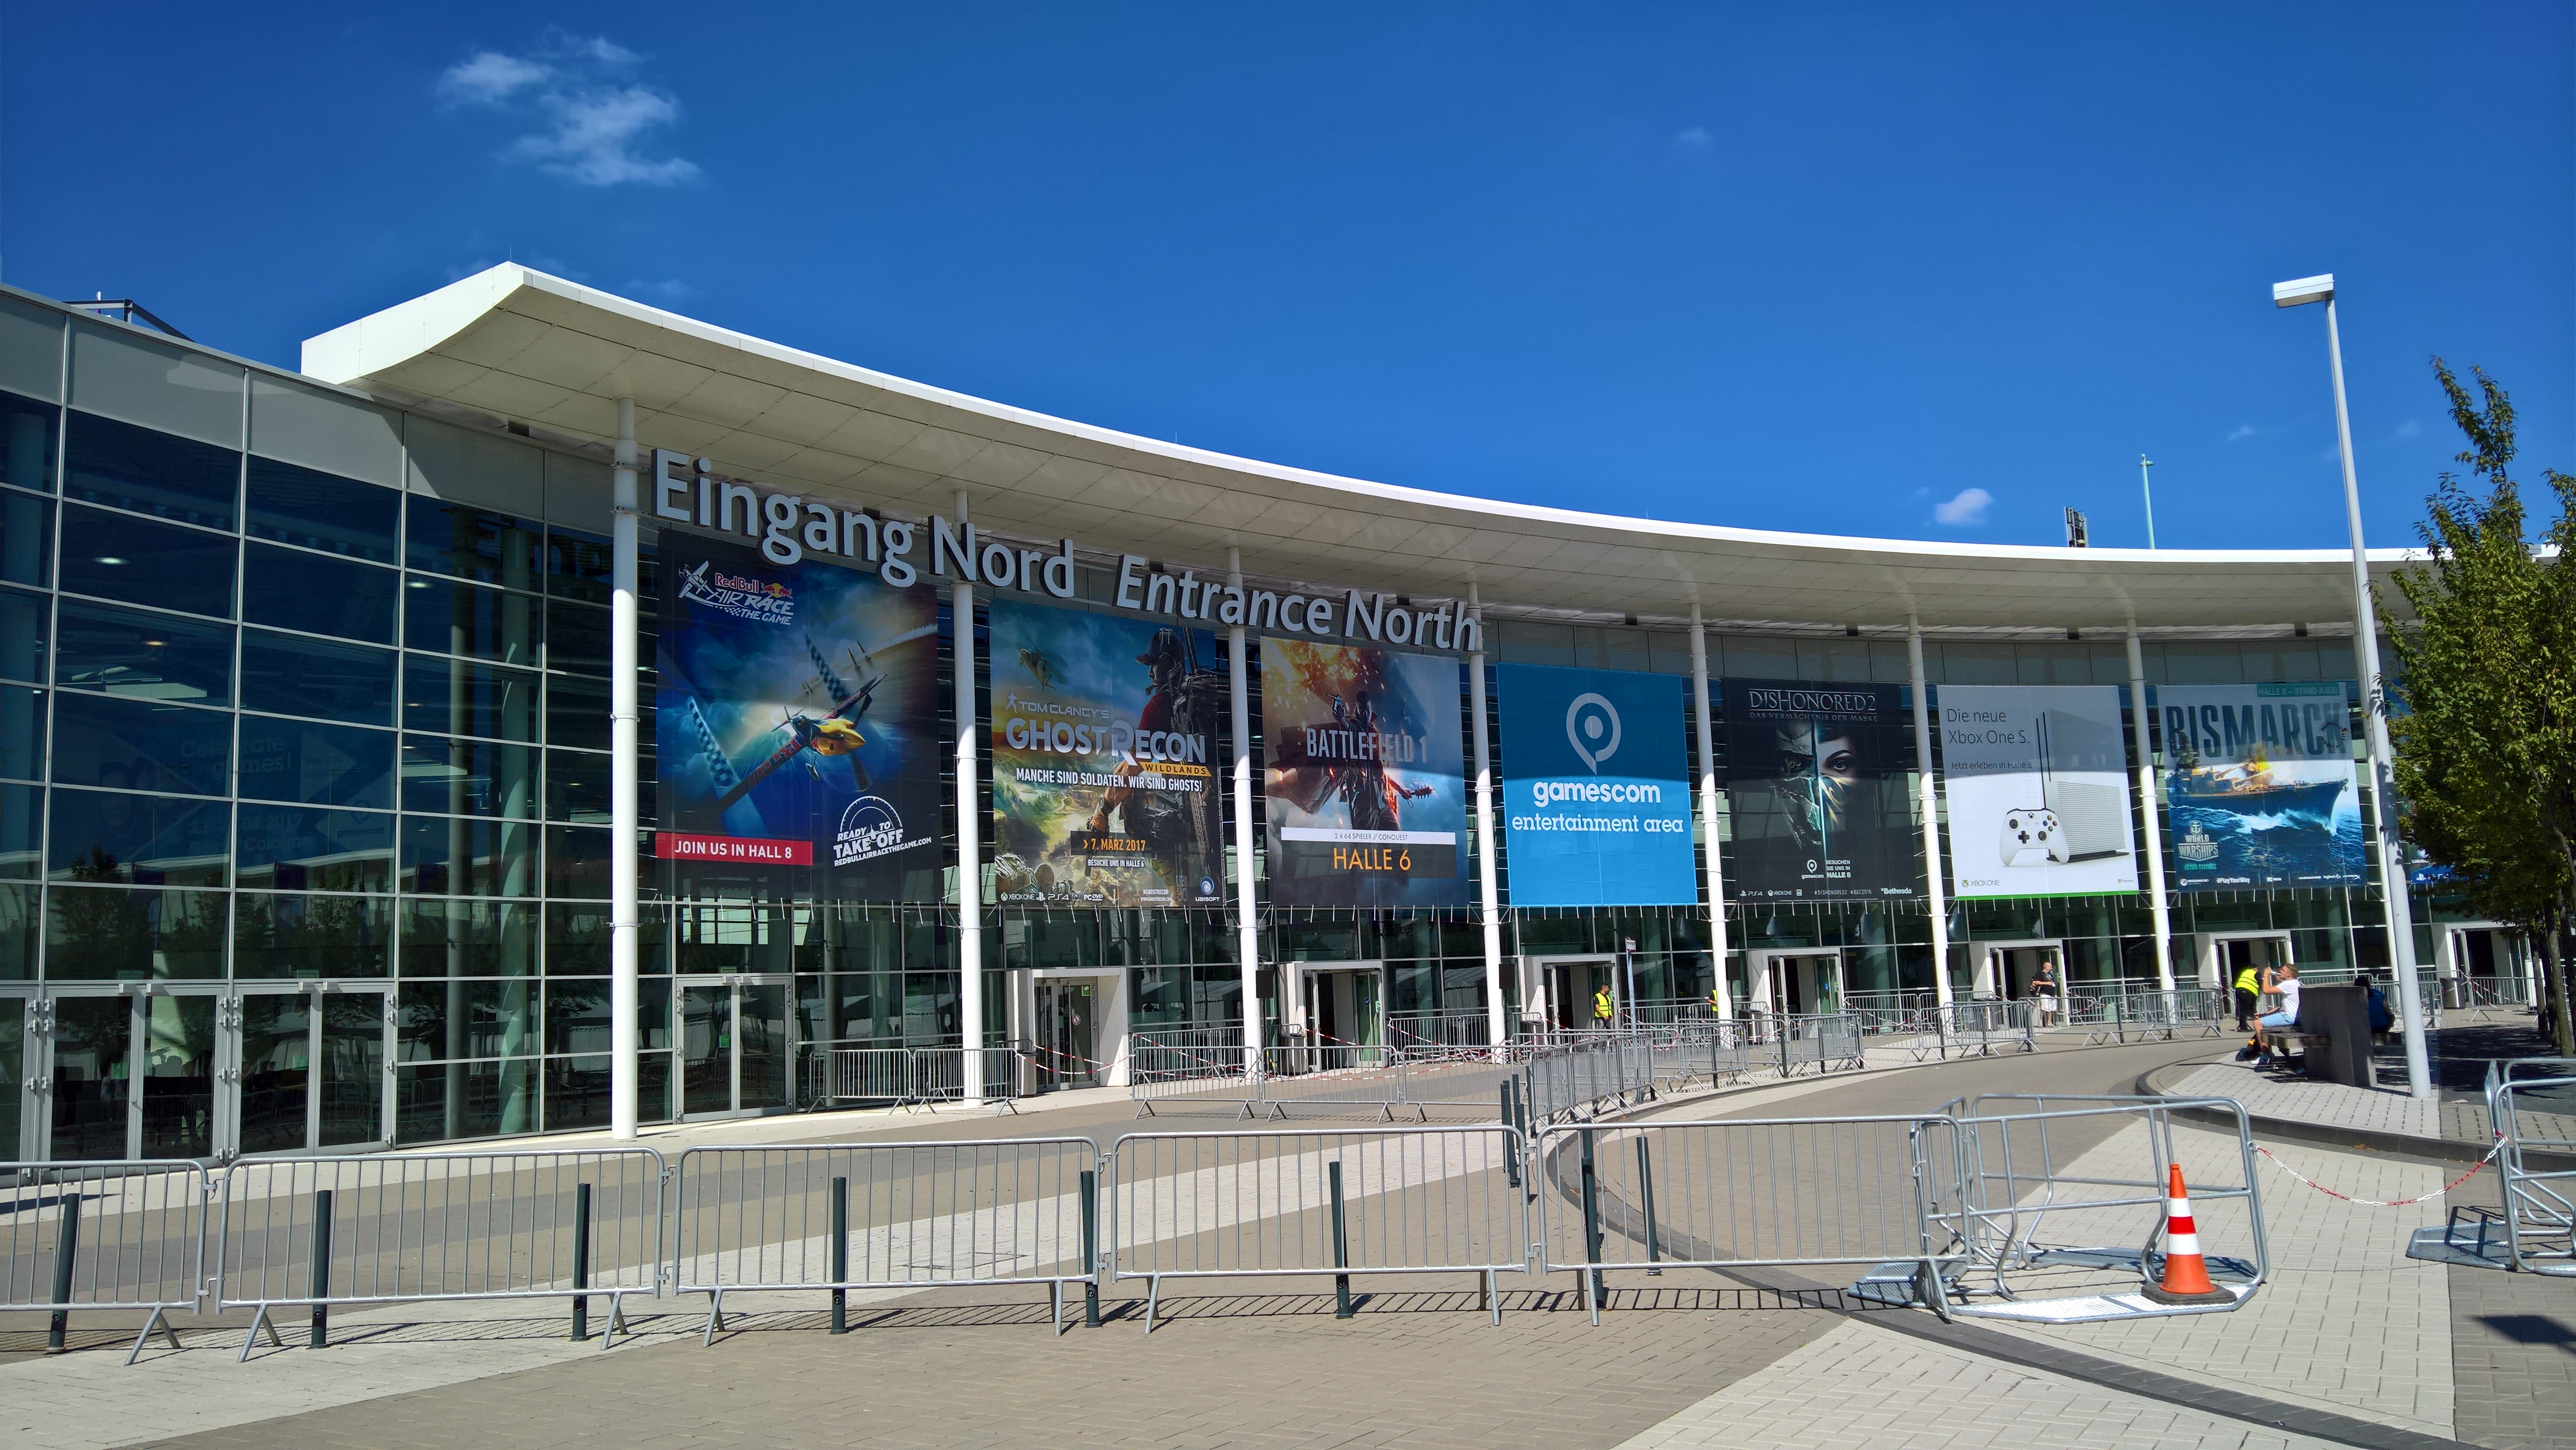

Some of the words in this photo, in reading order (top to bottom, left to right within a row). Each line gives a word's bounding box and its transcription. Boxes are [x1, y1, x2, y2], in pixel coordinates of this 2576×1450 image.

[651, 448, 917, 588] Eingang
[928, 515, 1074, 598] Nord
[715, 573, 737, 589] Red
[738, 577, 759, 593] Bull
[744, 594, 795, 616] RACE
[1113, 554, 1332, 634] Entrance
[1342, 590, 1477, 651] North
[738, 609, 761, 620] THE
[762, 613, 792, 625] GAME
[1019, 700, 1047, 713] TOM
[1049, 704, 1109, 719] CLANCY'S
[1749, 690, 1866, 712] DISHONORED
[1867, 695, 1877, 711] 2
[1769, 712, 1829, 721] VERMÄCHTNIS
[1947, 709, 1969, 722] Die
[1974, 712, 2006, 722] neue
[1949, 729, 1983, 744] Xbox
[1987, 730, 2014, 744] One
[2019, 730, 2030, 743] S.
[2166, 702, 2347, 758] BISMARCK
[1306, 728, 1413, 763] BATTLEFIELD
[1419, 736, 1427, 764] 1
[1145, 764, 1206, 775] WILDLANDS
[1970, 761, 1997, 769] erleben
[1016, 767, 1054, 783] MANCHE
[1057, 771, 1078, 784] SIND
[1081, 773, 1127, 787] SOLDATEN.
[1128, 776, 1145, 789] WIR
[1147, 777, 1167, 790] SIND
[1168, 778, 1202, 792] GHOSTS!
[1533, 781, 1661, 807] gamescom
[837, 827, 867, 842] READY
[879, 821, 891, 831] TO
[1512, 813, 1639, 832] entertainment
[1643, 818, 1684, 833] area
[833, 837, 871, 859] TAKE
[877, 829, 903, 847] OFF
[1091, 838, 1099, 850] 7.
[1101, 835, 1124, 851] MÄRZ
[1126, 840, 1146, 851] 2017
[2185, 834, 2209, 843] WORLD
[675, 841, 705, 854] JOIN
[711, 843, 727, 855] US
[731, 844, 744, 856] IN
[749, 845, 781, 858] HALL
[785, 847, 792, 859] 8
[834, 837, 931, 867] REDBULLAIRRACETHEGAME.COM
[1333, 847, 1393, 870] HALLE
[1399, 849, 1411, 871] 6
[2179, 845, 2218, 859] WARSHIPS
